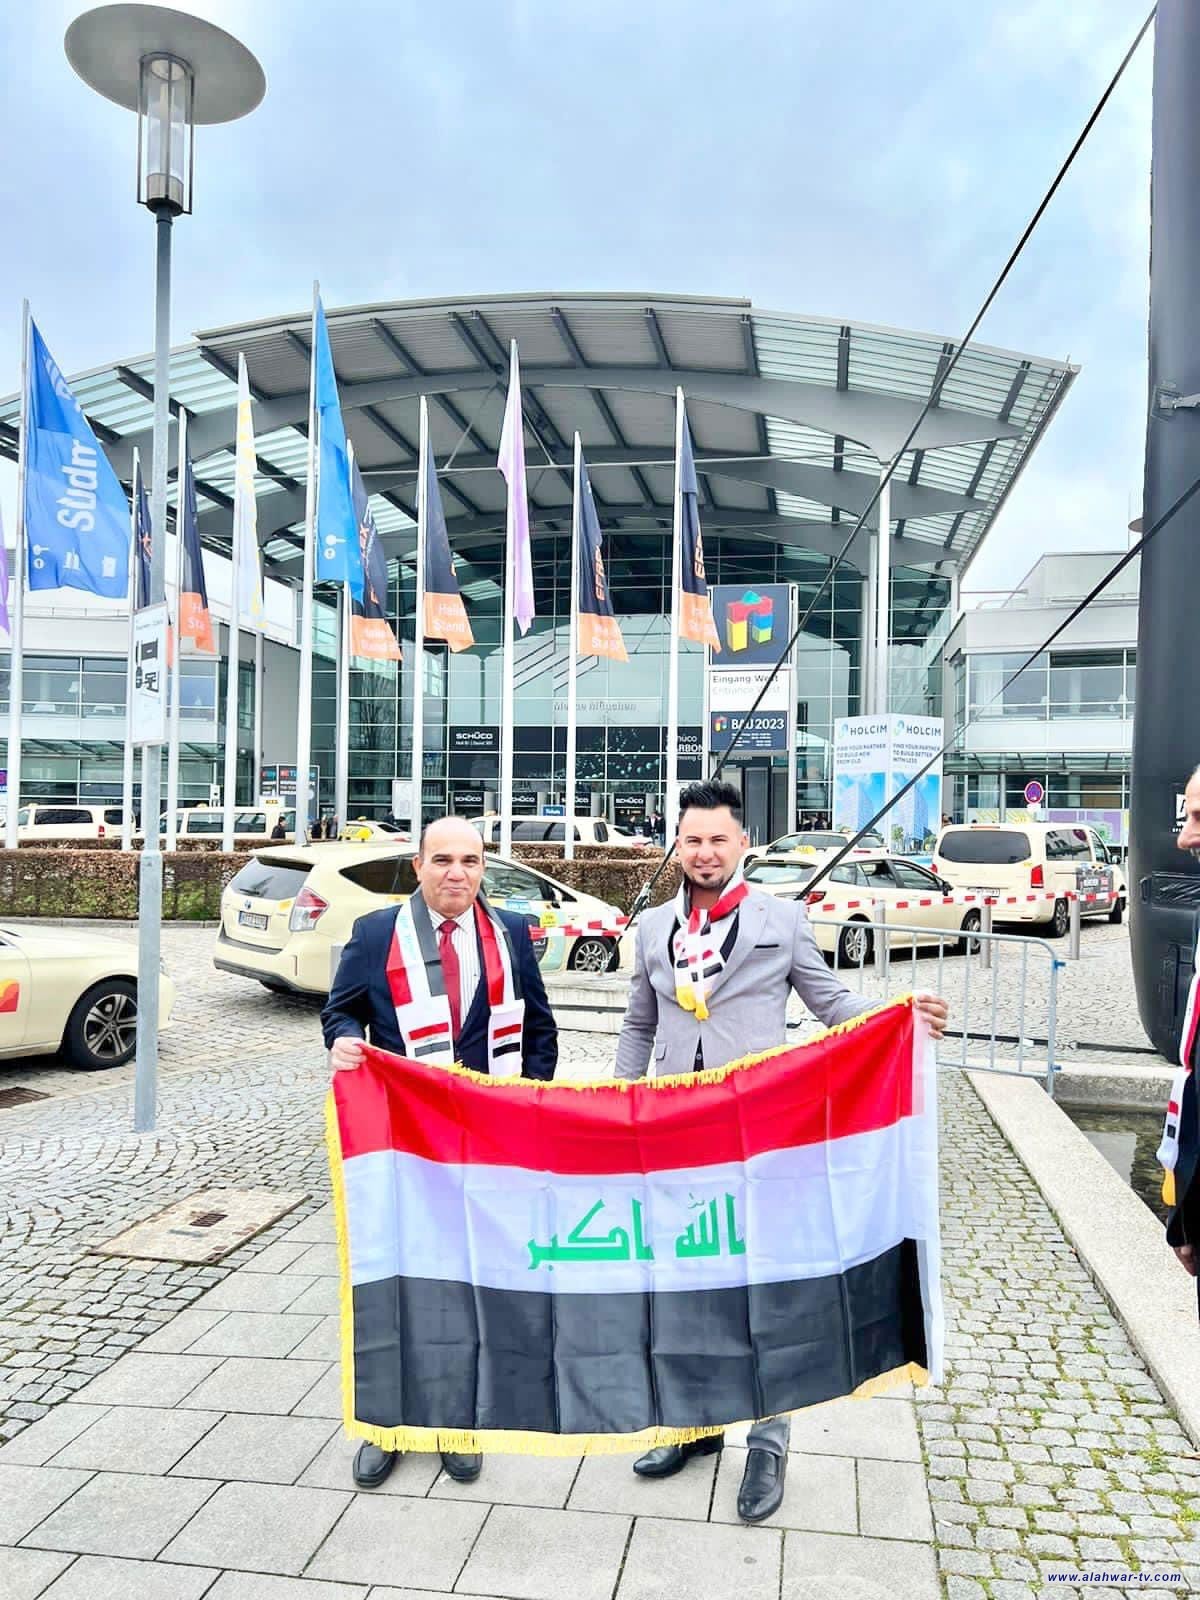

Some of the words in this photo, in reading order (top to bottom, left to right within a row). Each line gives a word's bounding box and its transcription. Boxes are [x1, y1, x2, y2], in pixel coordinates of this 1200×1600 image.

[713, 675, 751, 684] Eingang
[850, 724, 887, 736] HOLCIM
[906, 725, 942, 737] HOLCIM
[456, 731, 493, 740] SCHÜCO
